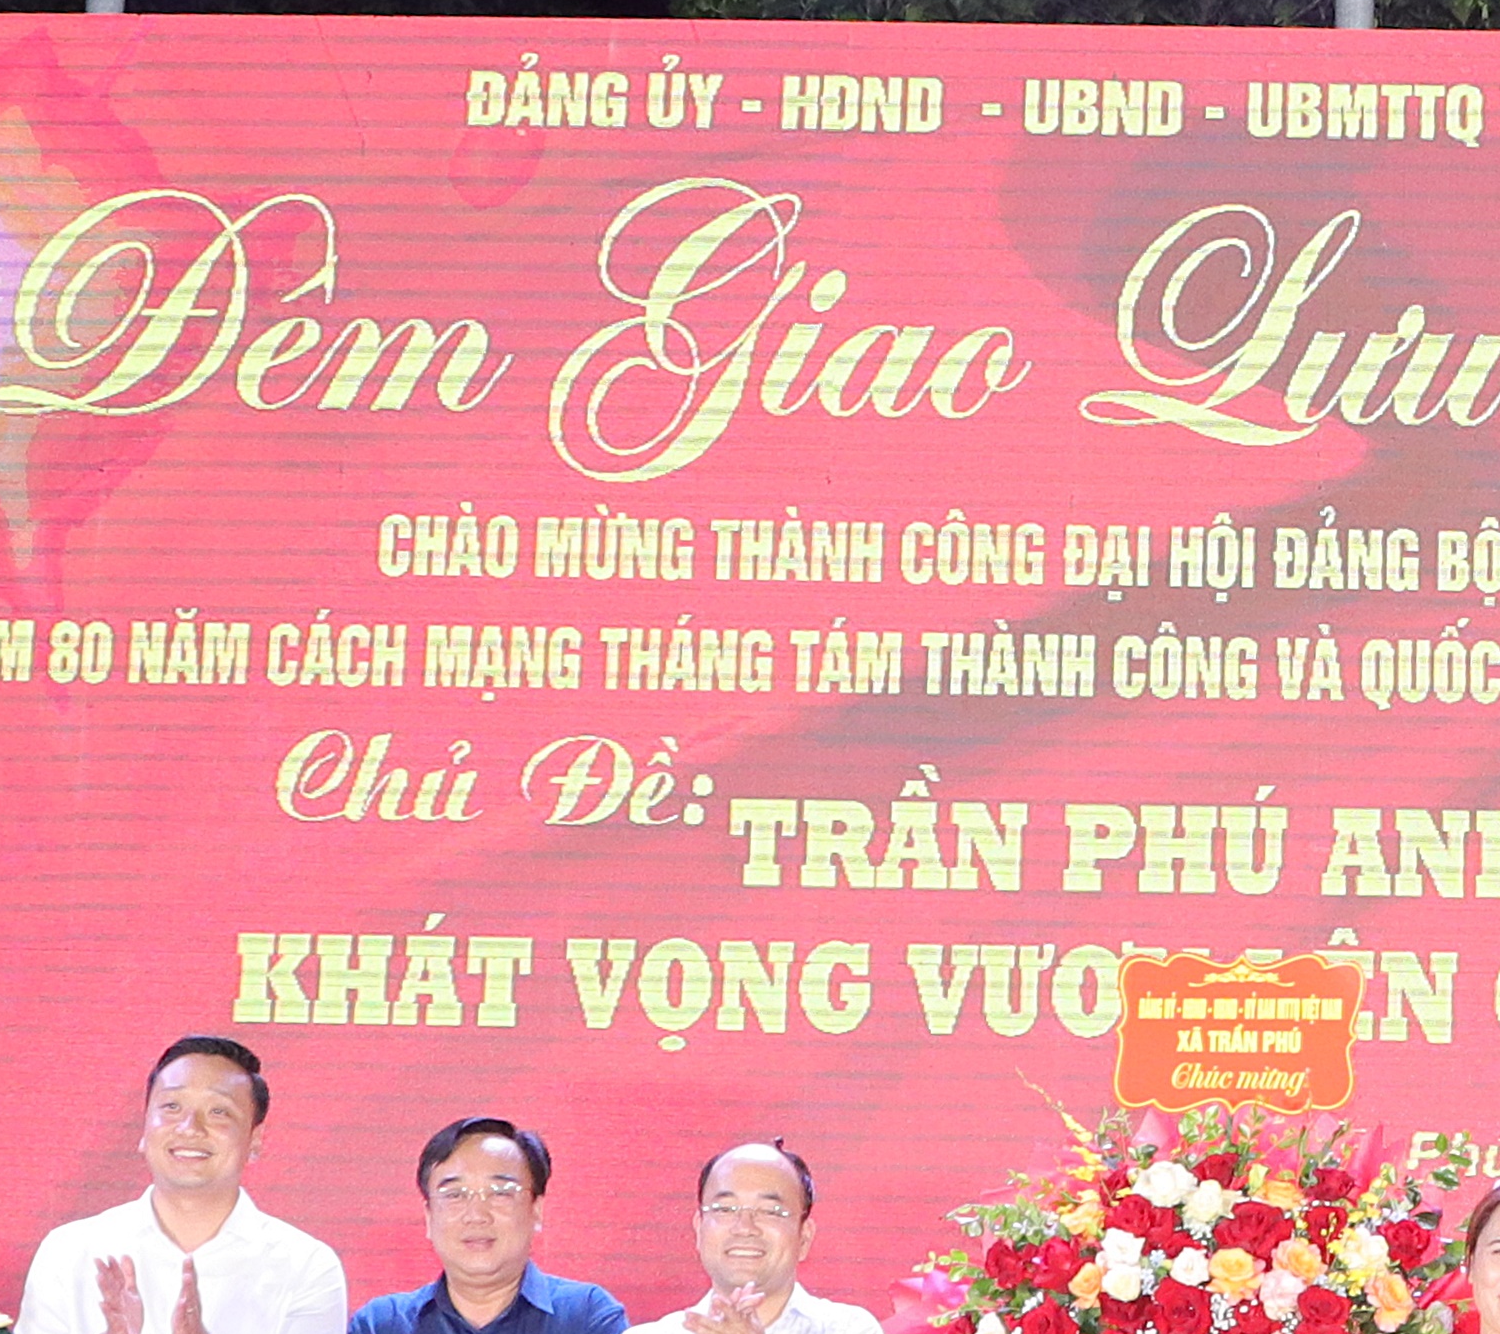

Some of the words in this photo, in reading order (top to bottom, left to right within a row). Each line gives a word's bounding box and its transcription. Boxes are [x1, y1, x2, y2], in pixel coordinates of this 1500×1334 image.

[466, 53, 629, 128] ĐẢNG
[648, 54, 723, 129] ỦY
[781, 75, 944, 133] HĐND
[1024, 79, 1184, 136] UBND
[1247, 82, 1484, 148] UBMTTQ
[549, 177, 1032, 482] Giao
[379, 502, 519, 578] CHÀO
[535, 504, 695, 581] MỪNG
[710, 506, 885, 582] THÀNH
[900, 509, 1046, 585] CÔNG
[1063, 525, 1152, 602] ĐẠI
[1169, 512, 1257, 604] HỘI
[1272, 505, 1420, 599] ĐẢNG
[48, 621, 114, 684] 80
[128, 608, 251, 684] NĂM
[267, 609, 407, 687] CÁCH
[425, 625, 583, 701] MẠNG
[600, 615, 775, 693] THÁNG
[790, 617, 904, 695] TÁM
[921, 619, 1100, 698] THÀNH
[1112, 621, 1259, 700] CÔNG
[1276, 623, 1346, 701] VÀ
[276, 730, 478, 821] Chủ
[522, 735, 714, 826] Đề:
[729, 764, 1029, 891] TRẦN
[1063, 785, 1289, 895] PHÚ
[233, 913, 534, 1027] KHÁT
[566, 937, 873, 1051] VỌNG
[907, 940, 1211, 1038] VƯƠ
[1171, 1062, 1234, 1089] Chúc
[1235, 1065, 1306, 1097] mừng
[1262, 1026, 1301, 1054] PHÚ
